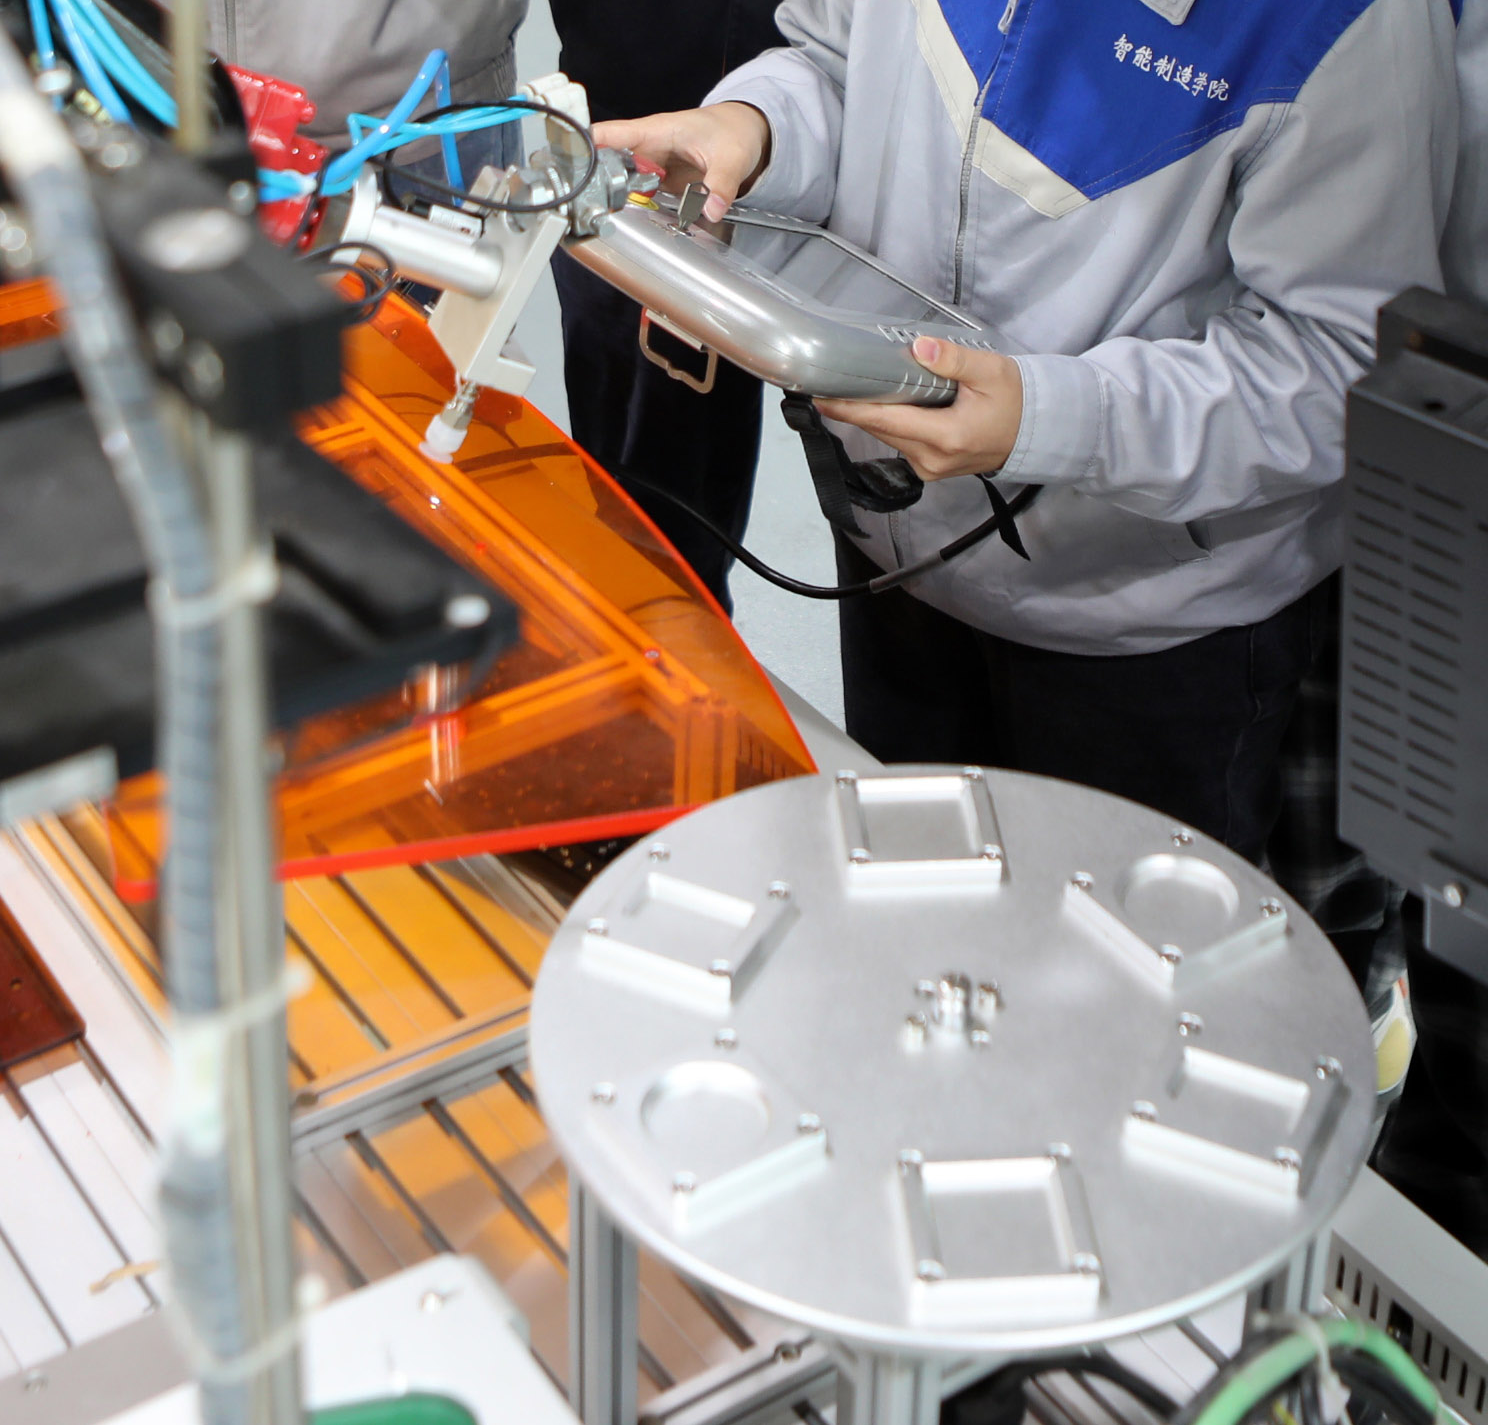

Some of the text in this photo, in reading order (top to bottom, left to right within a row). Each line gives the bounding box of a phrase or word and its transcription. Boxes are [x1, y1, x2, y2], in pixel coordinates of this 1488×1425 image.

[1113, 33, 1229, 101] 智能制造学院
